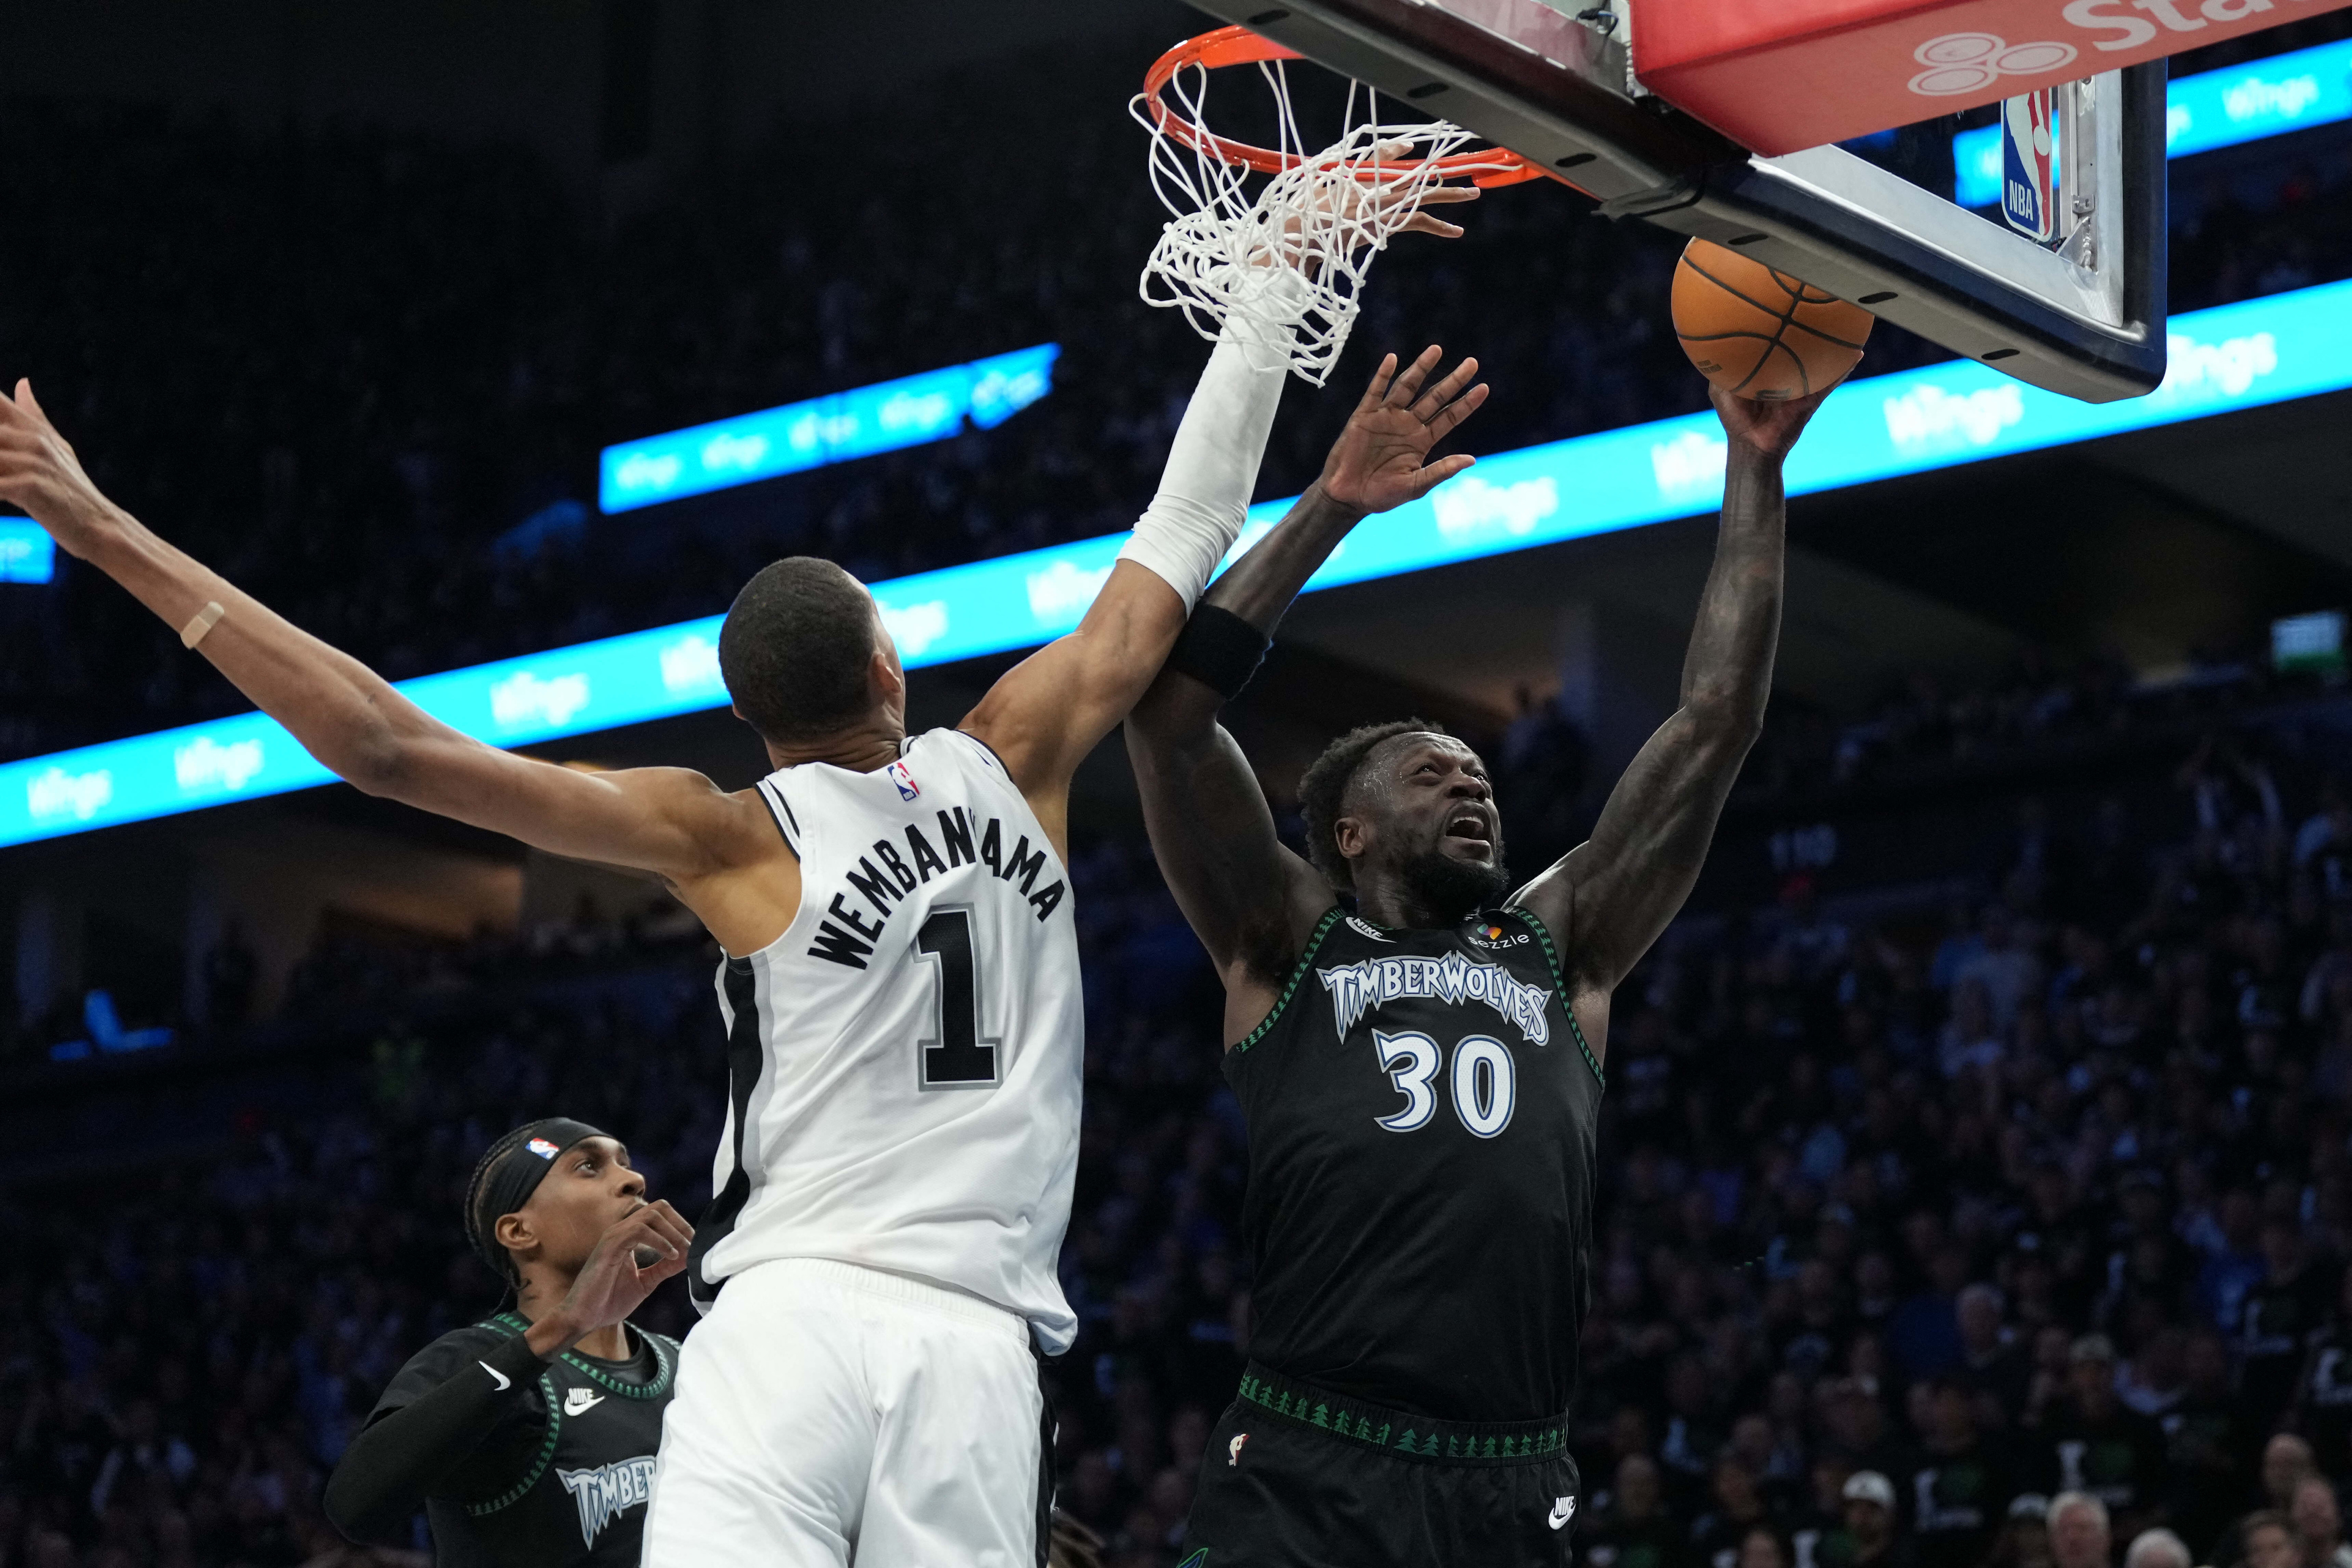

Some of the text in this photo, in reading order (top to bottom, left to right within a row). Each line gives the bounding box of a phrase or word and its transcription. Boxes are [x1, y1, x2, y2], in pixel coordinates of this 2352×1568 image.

[2009, 179, 2033, 222] NBA
[807, 806, 1065, 970] WEMBANAMA
[1353, 918, 1383, 936] NIKE
[1468, 934, 1530, 949] sezzle
[910, 902, 1003, 1091] 1
[1316, 950, 1553, 1046] TIMBERWOLVES
[1372, 1028, 1516, 1139] 30
[568, 1388, 593, 1404] NIKE
[1554, 1496, 1574, 1516] NIKE
